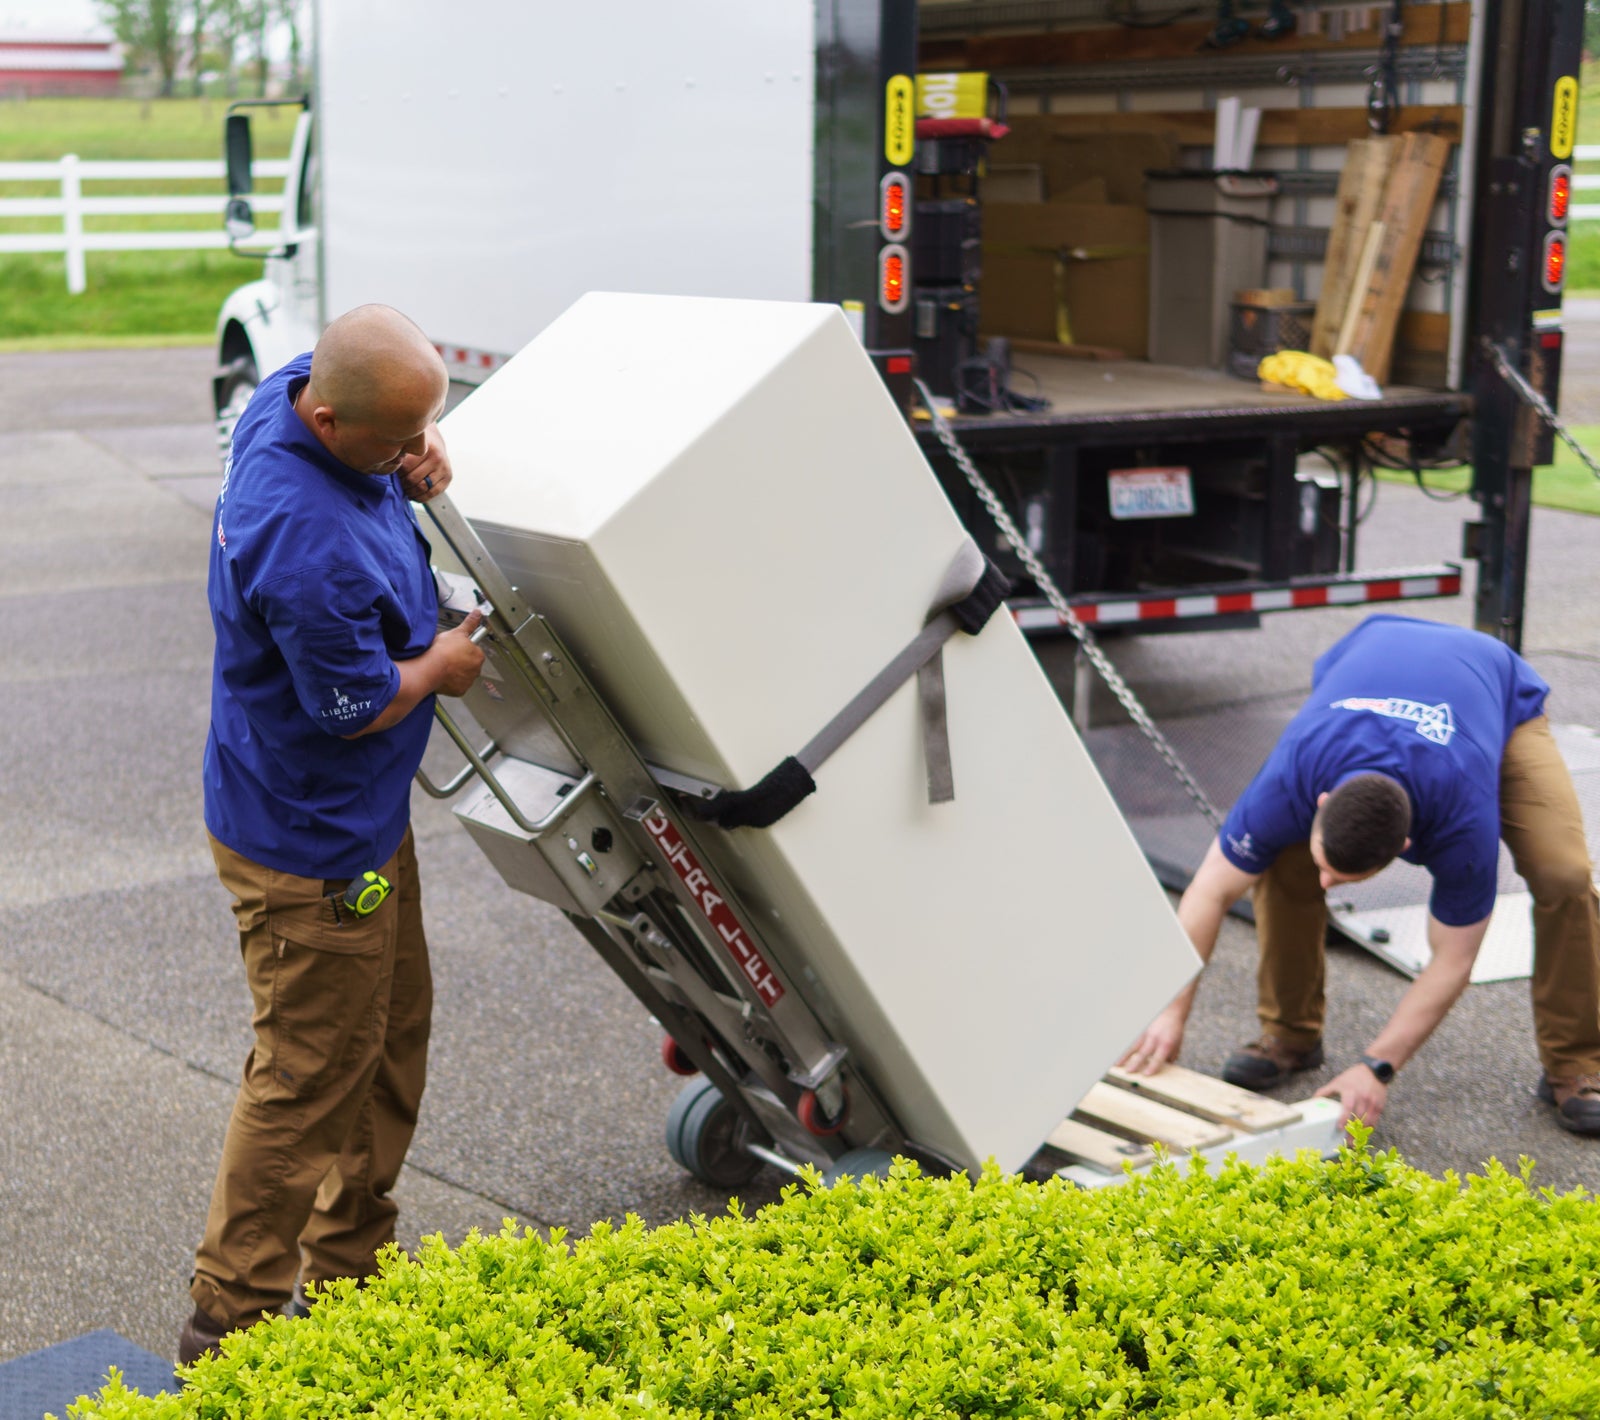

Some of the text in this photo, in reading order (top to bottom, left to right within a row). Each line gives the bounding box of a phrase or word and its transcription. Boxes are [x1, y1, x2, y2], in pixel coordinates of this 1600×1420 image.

[321, 700, 371, 718] LIBERTY
[339, 712, 357, 721] SAFE
[645, 808, 780, 998] ULTRA LIFT
